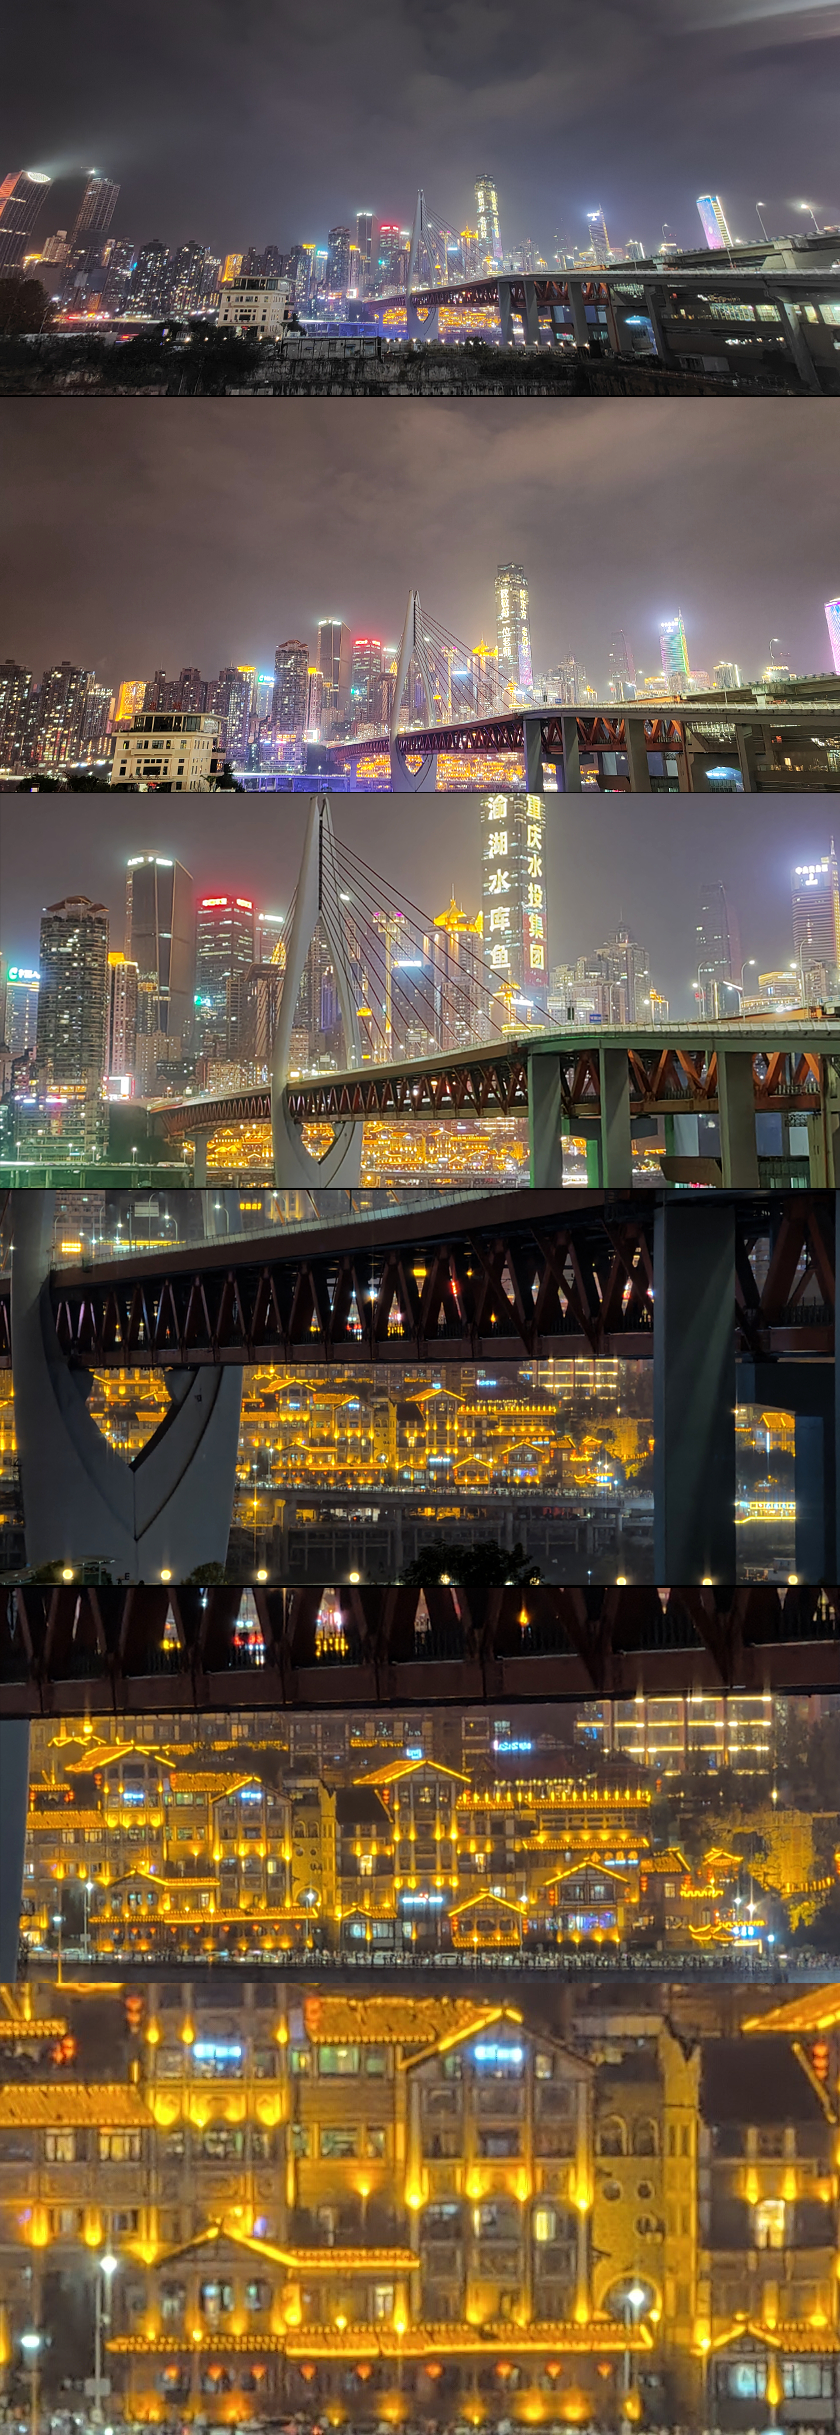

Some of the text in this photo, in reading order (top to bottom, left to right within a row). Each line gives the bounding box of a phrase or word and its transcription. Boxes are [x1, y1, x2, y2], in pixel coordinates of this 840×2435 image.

[488, 794, 511, 970] 渝湖水库鱼
[526, 794, 545, 970] 重庆水投集团
